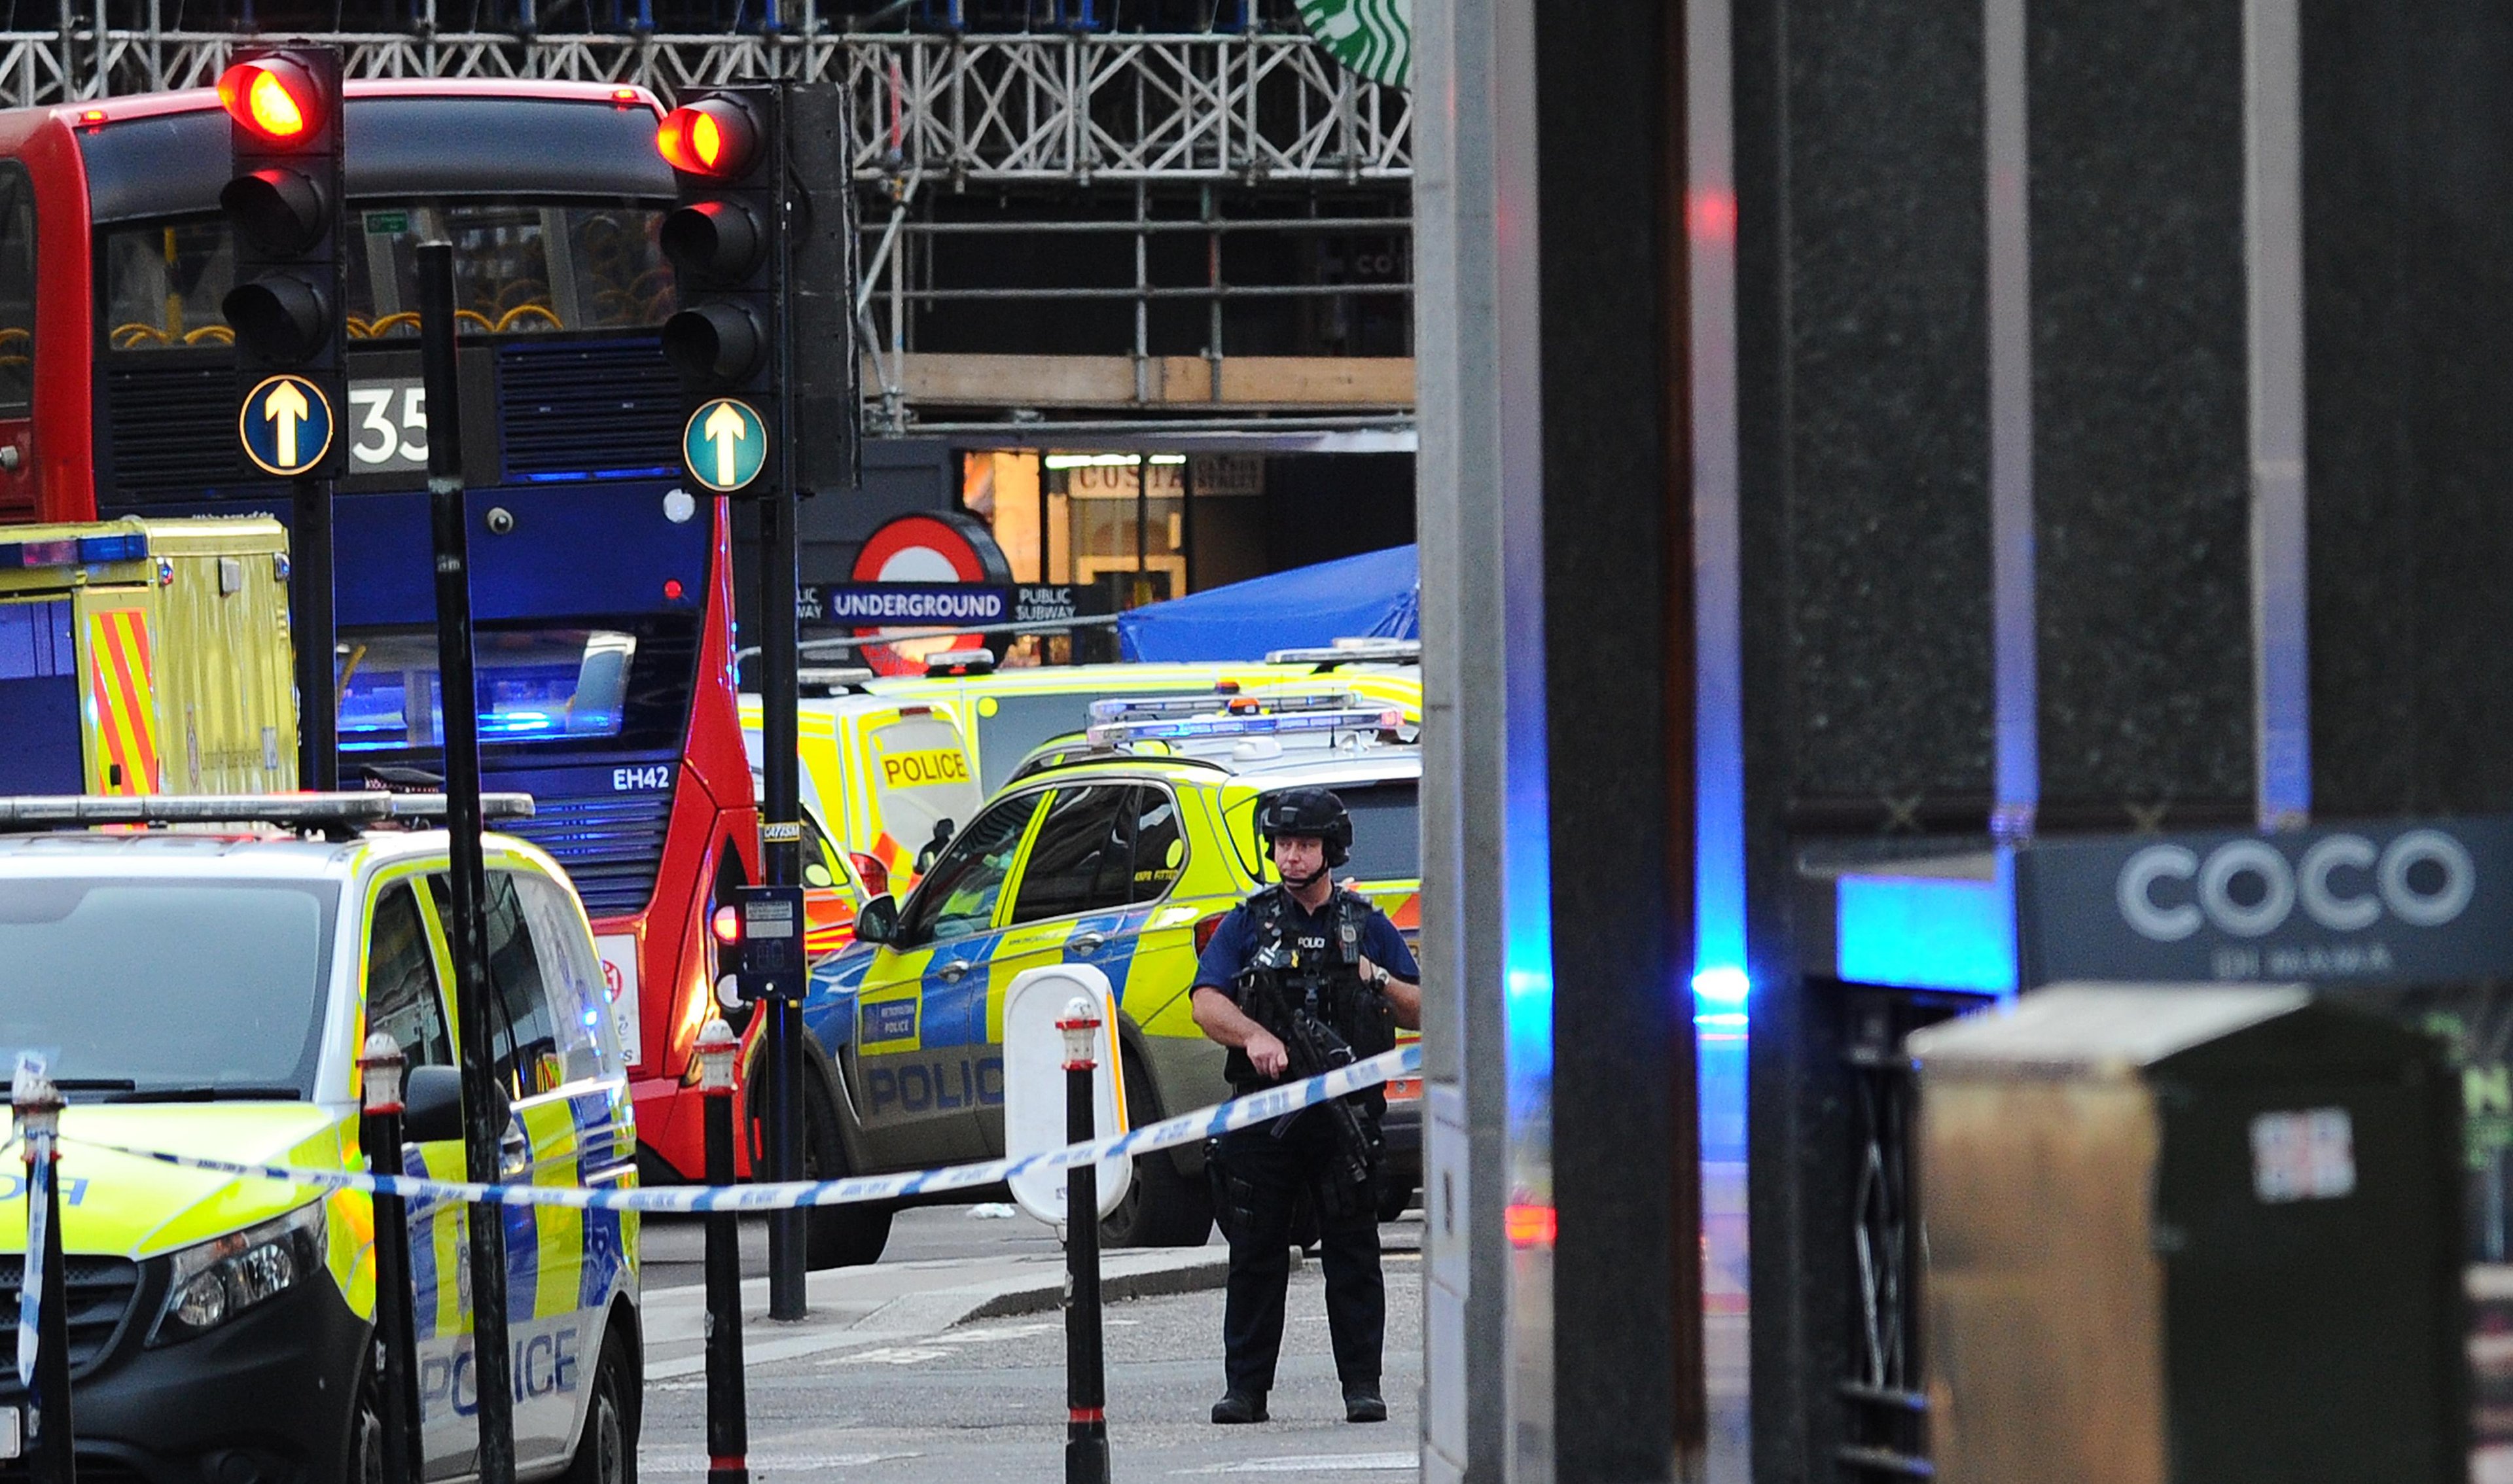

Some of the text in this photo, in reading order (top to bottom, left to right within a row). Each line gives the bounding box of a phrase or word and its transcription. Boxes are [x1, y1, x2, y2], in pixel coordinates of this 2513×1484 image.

[349, 387, 429, 463] 35
[834, 593, 1002, 617] UNDERGROUND
[1016, 605, 1077, 620] SUBWAY
[1019, 588, 1072, 605] PUBLIC
[613, 766, 669, 790] EH42
[884, 752, 969, 785] POLICE
[2116, 829, 2476, 941] COCO
[868, 1056, 1004, 1115] POLIC
[421, 1328, 577, 1424] POICE
